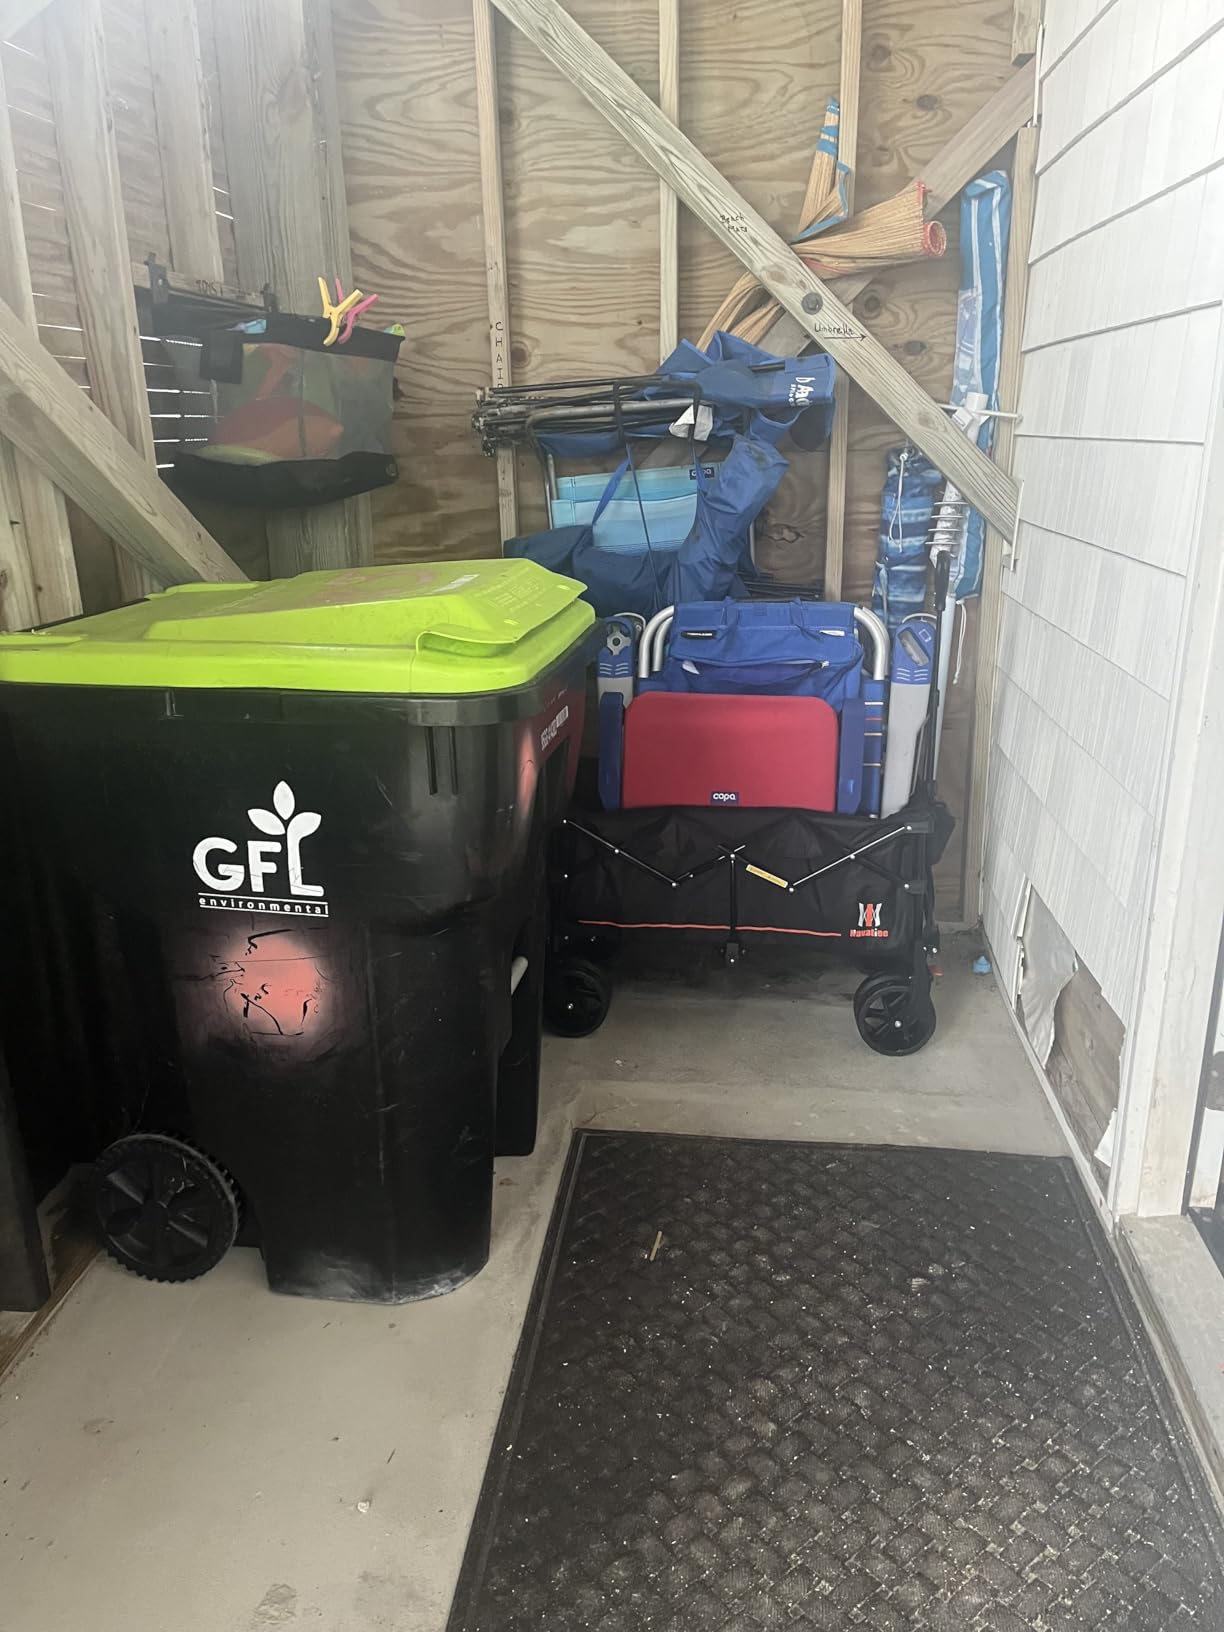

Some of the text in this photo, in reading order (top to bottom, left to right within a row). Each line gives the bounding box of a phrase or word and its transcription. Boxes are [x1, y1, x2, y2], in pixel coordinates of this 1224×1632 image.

[712, 792, 736, 802] copa
[192, 811, 324, 897] GFL
[198, 896, 329, 915] environmental
